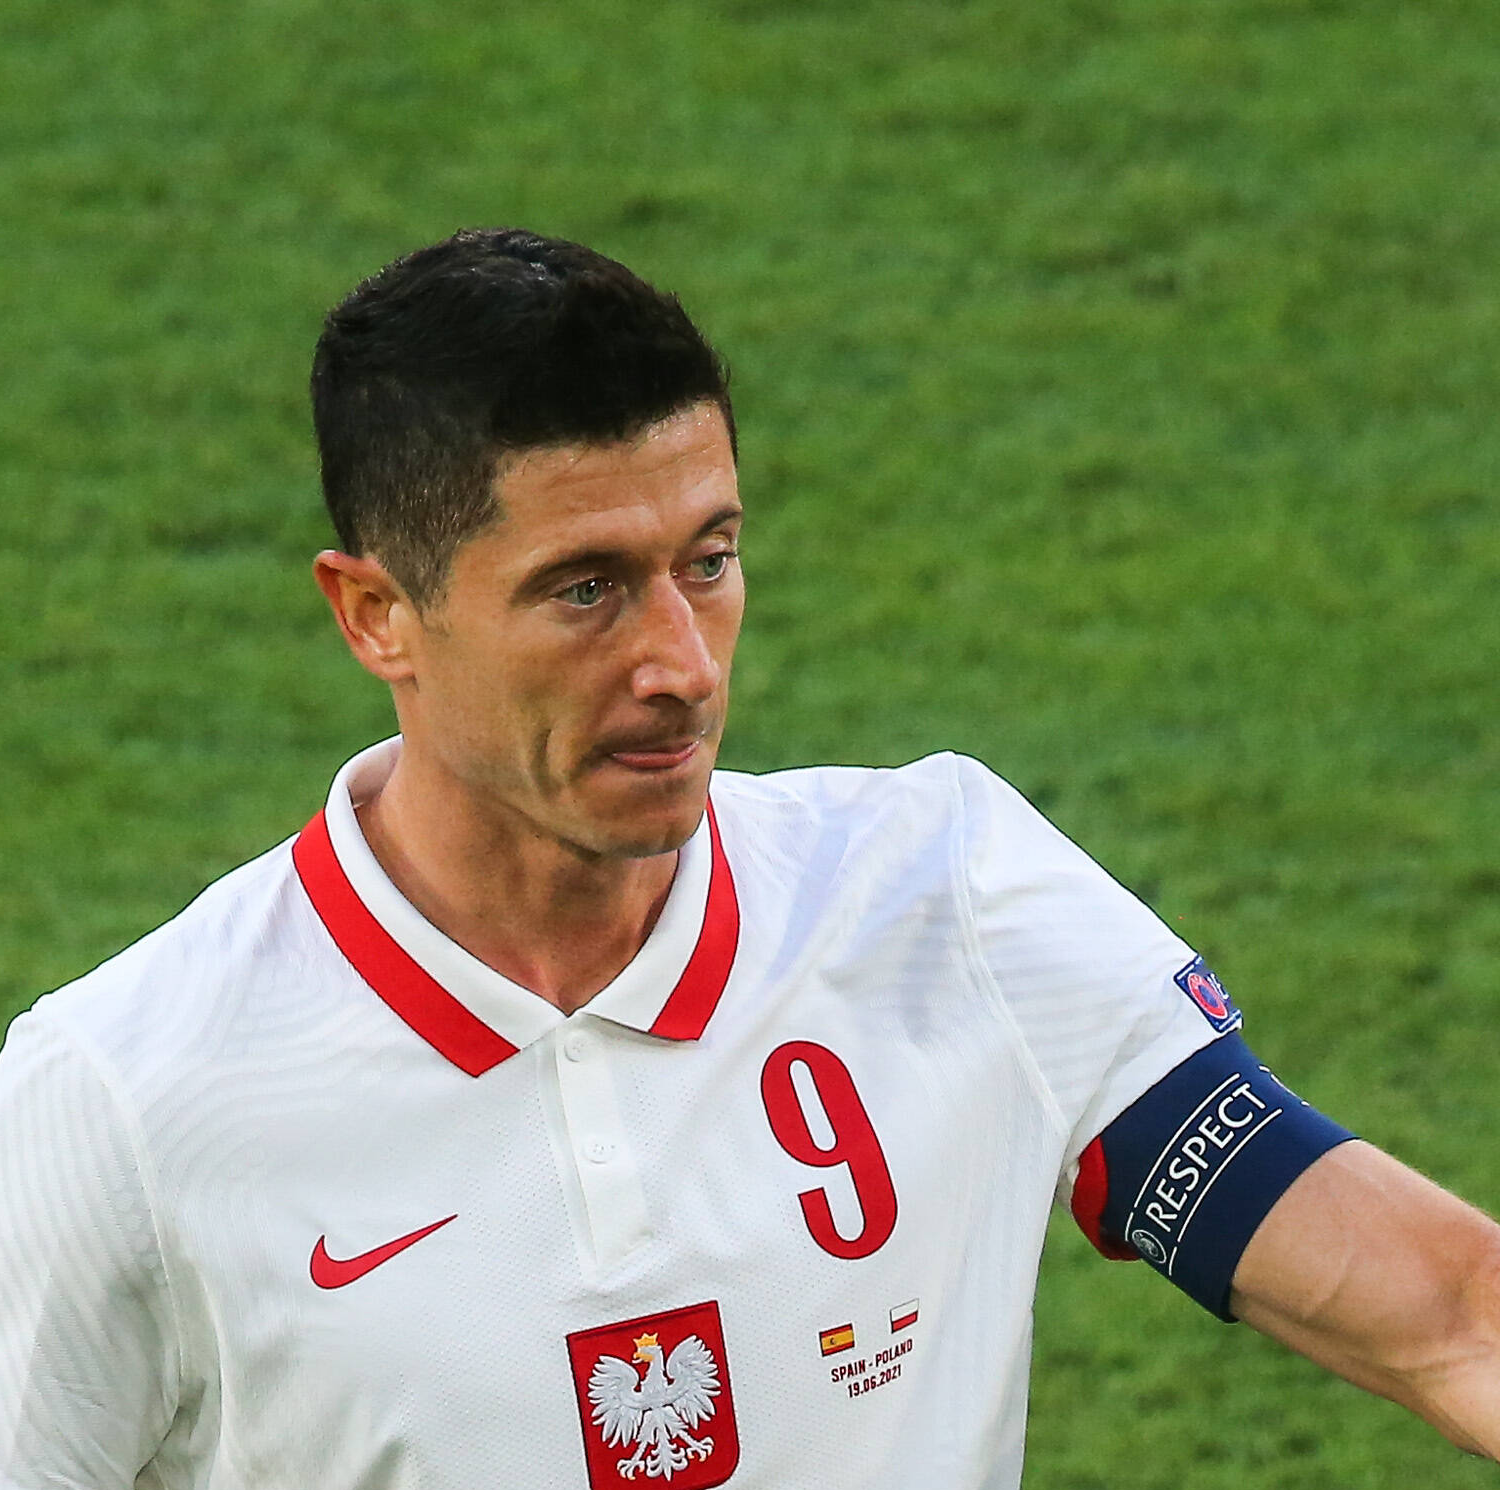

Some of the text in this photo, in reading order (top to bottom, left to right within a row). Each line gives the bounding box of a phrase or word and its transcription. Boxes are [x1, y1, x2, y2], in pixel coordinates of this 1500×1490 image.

[760, 1040, 898, 1261] 9
[1145, 1082, 1266, 1233] RESPECT
[831, 1359, 866, 1382] SPAIN
[875, 1338, 913, 1367] POLAND
[847, 1365, 901, 1398] 19.06.2021
